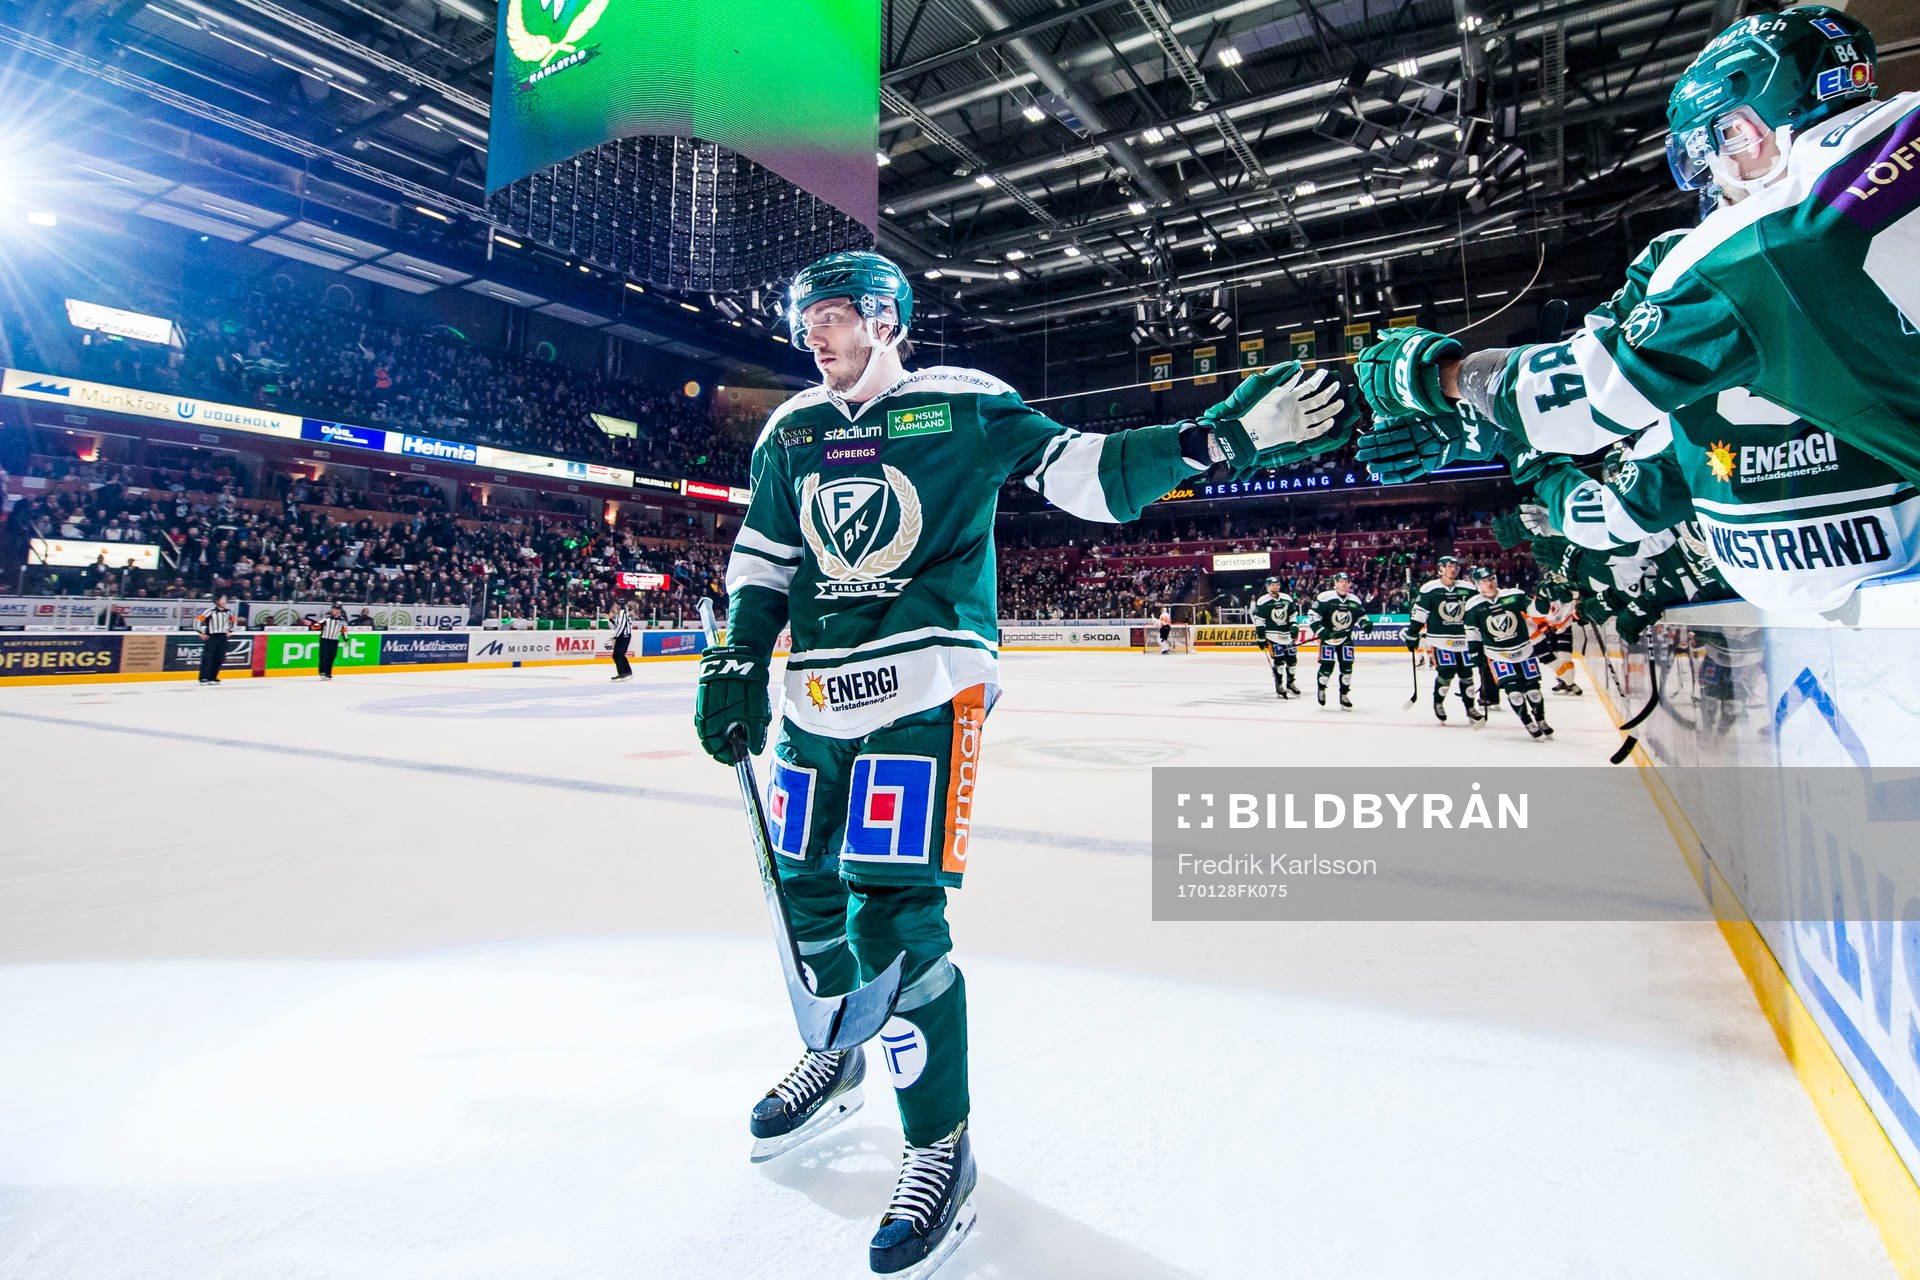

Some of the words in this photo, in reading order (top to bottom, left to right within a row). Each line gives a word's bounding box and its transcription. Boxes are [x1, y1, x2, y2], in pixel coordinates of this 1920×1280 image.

[1834, 43, 1859, 62] 84
[1297, 343, 1310, 359] 2
[1352, 335, 1365, 351] 9
[1200, 359, 1211, 373] 9
[1247, 351, 1258, 366] 5
[1154, 366, 1169, 380] 21
[81, 387, 170, 414] Munkfors
[203, 409, 281, 429] UDDEHOLM
[894, 418, 945, 432] VÄRMLAND
[823, 425, 883, 441] stadium
[826, 448, 876, 460] LÖFBERGS
[1739, 431, 1838, 477] ENERGI
[1740, 463, 1840, 484] karlstadsenergi.se
[1205, 475, 1331, 495] RESTAURANG
[1344, 473, 1355, 484] &
[831, 583, 886, 593] KARLSTAD
[556, 636, 595, 652] MAXI
[1003, 632, 1064, 644] goodtech
[383, 640, 409, 653] Max
[409, 640, 468, 653] Matthiessen
[508, 644, 551, 653] MIDROC
[827, 665, 899, 705] ENERGI
